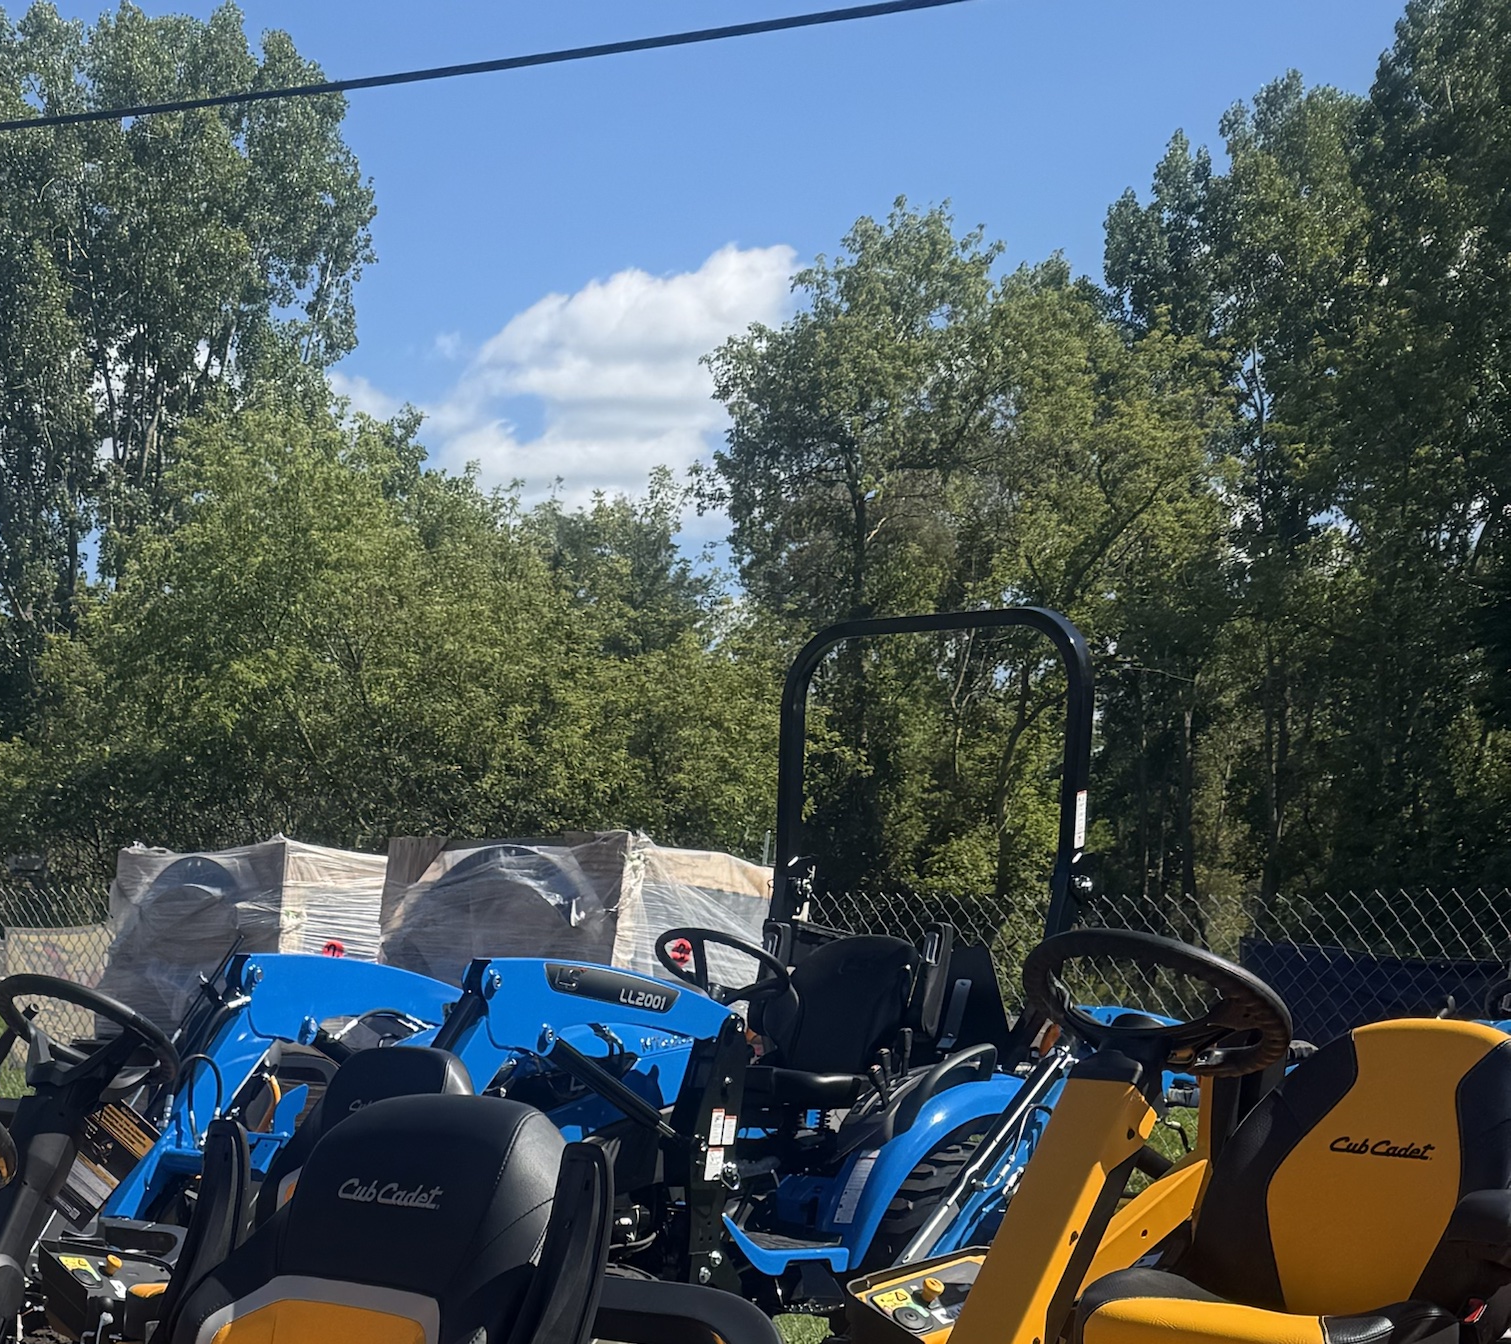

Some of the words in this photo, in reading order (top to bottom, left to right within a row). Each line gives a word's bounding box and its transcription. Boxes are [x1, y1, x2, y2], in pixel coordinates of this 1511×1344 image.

[619, 988, 667, 1011] LL2001
[1329, 1136, 1370, 1155] Cub
[1370, 1140, 1436, 1161] Cadet
[338, 1177, 379, 1202] Cub
[377, 1182, 444, 1210] Cadet
